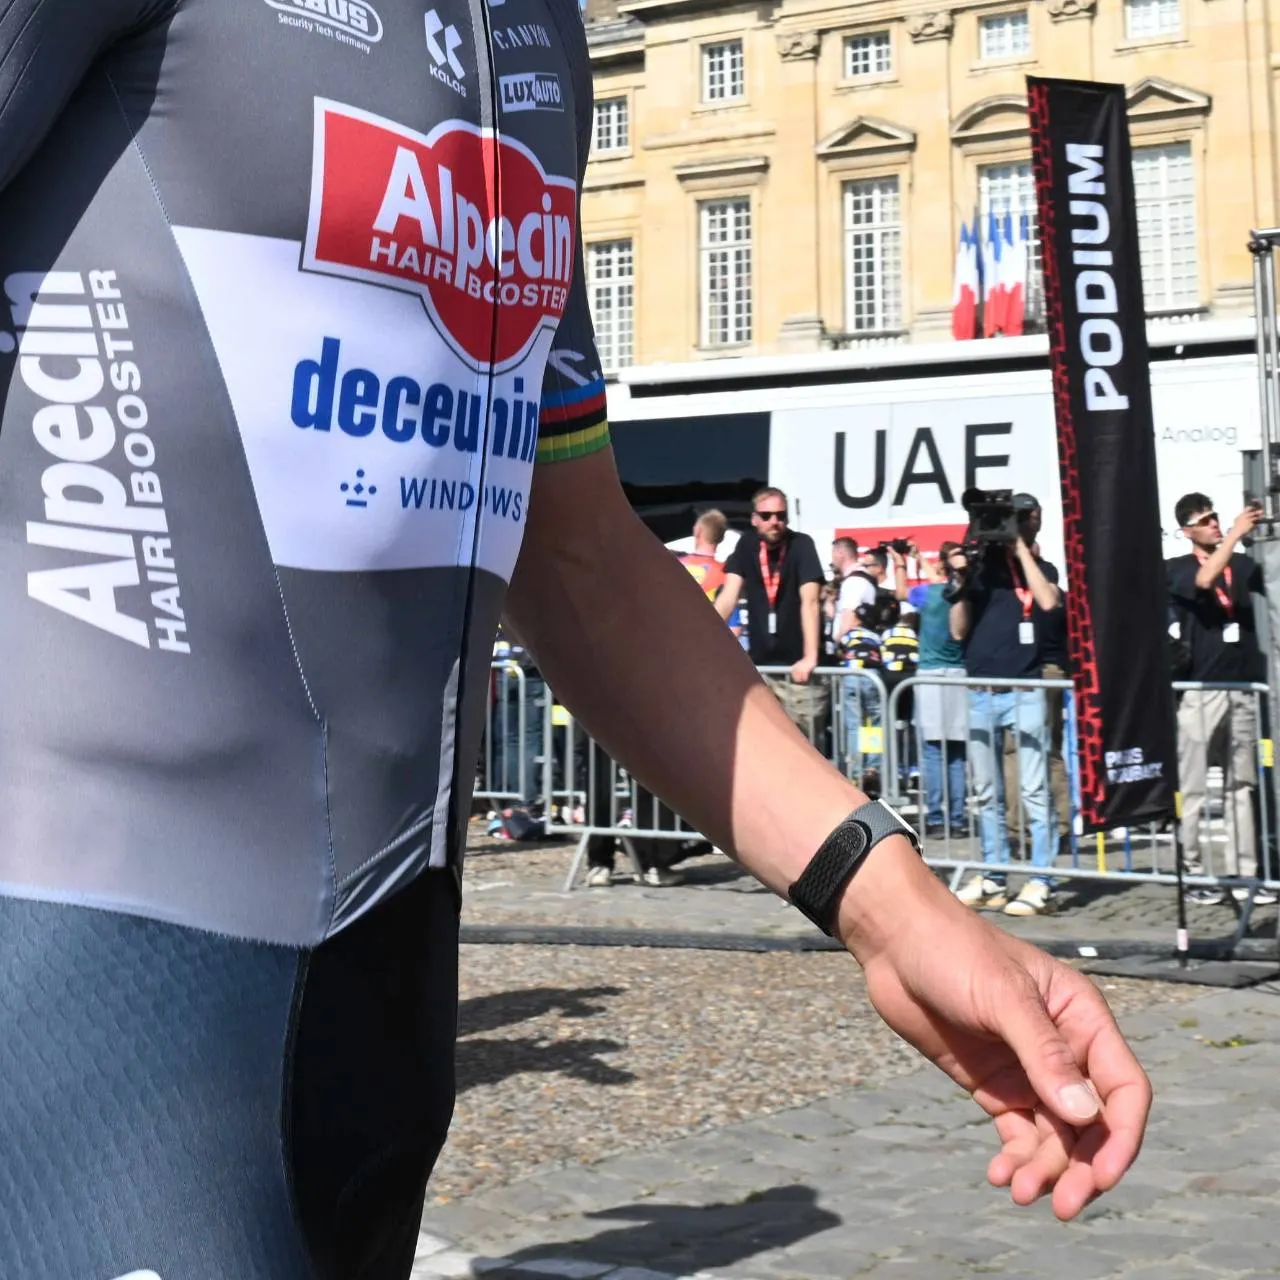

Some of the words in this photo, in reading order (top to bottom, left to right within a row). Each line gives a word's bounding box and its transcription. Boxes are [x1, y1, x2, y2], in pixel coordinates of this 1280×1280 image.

[278, 12, 314, 33] Security
[315, 22, 334, 38] Tech
[335, 32, 371, 55] Germany
[370, 235, 455, 285] HAIR
[372, 145, 572, 291] Alpecin
[1065, 143, 1130, 411] PODIUM
[88, 268, 164, 505] BOOSTER
[400, 476, 523, 522] WINDWS
[833, 421, 1014, 509] UAE
[142, 534, 191, 655] HAIR
